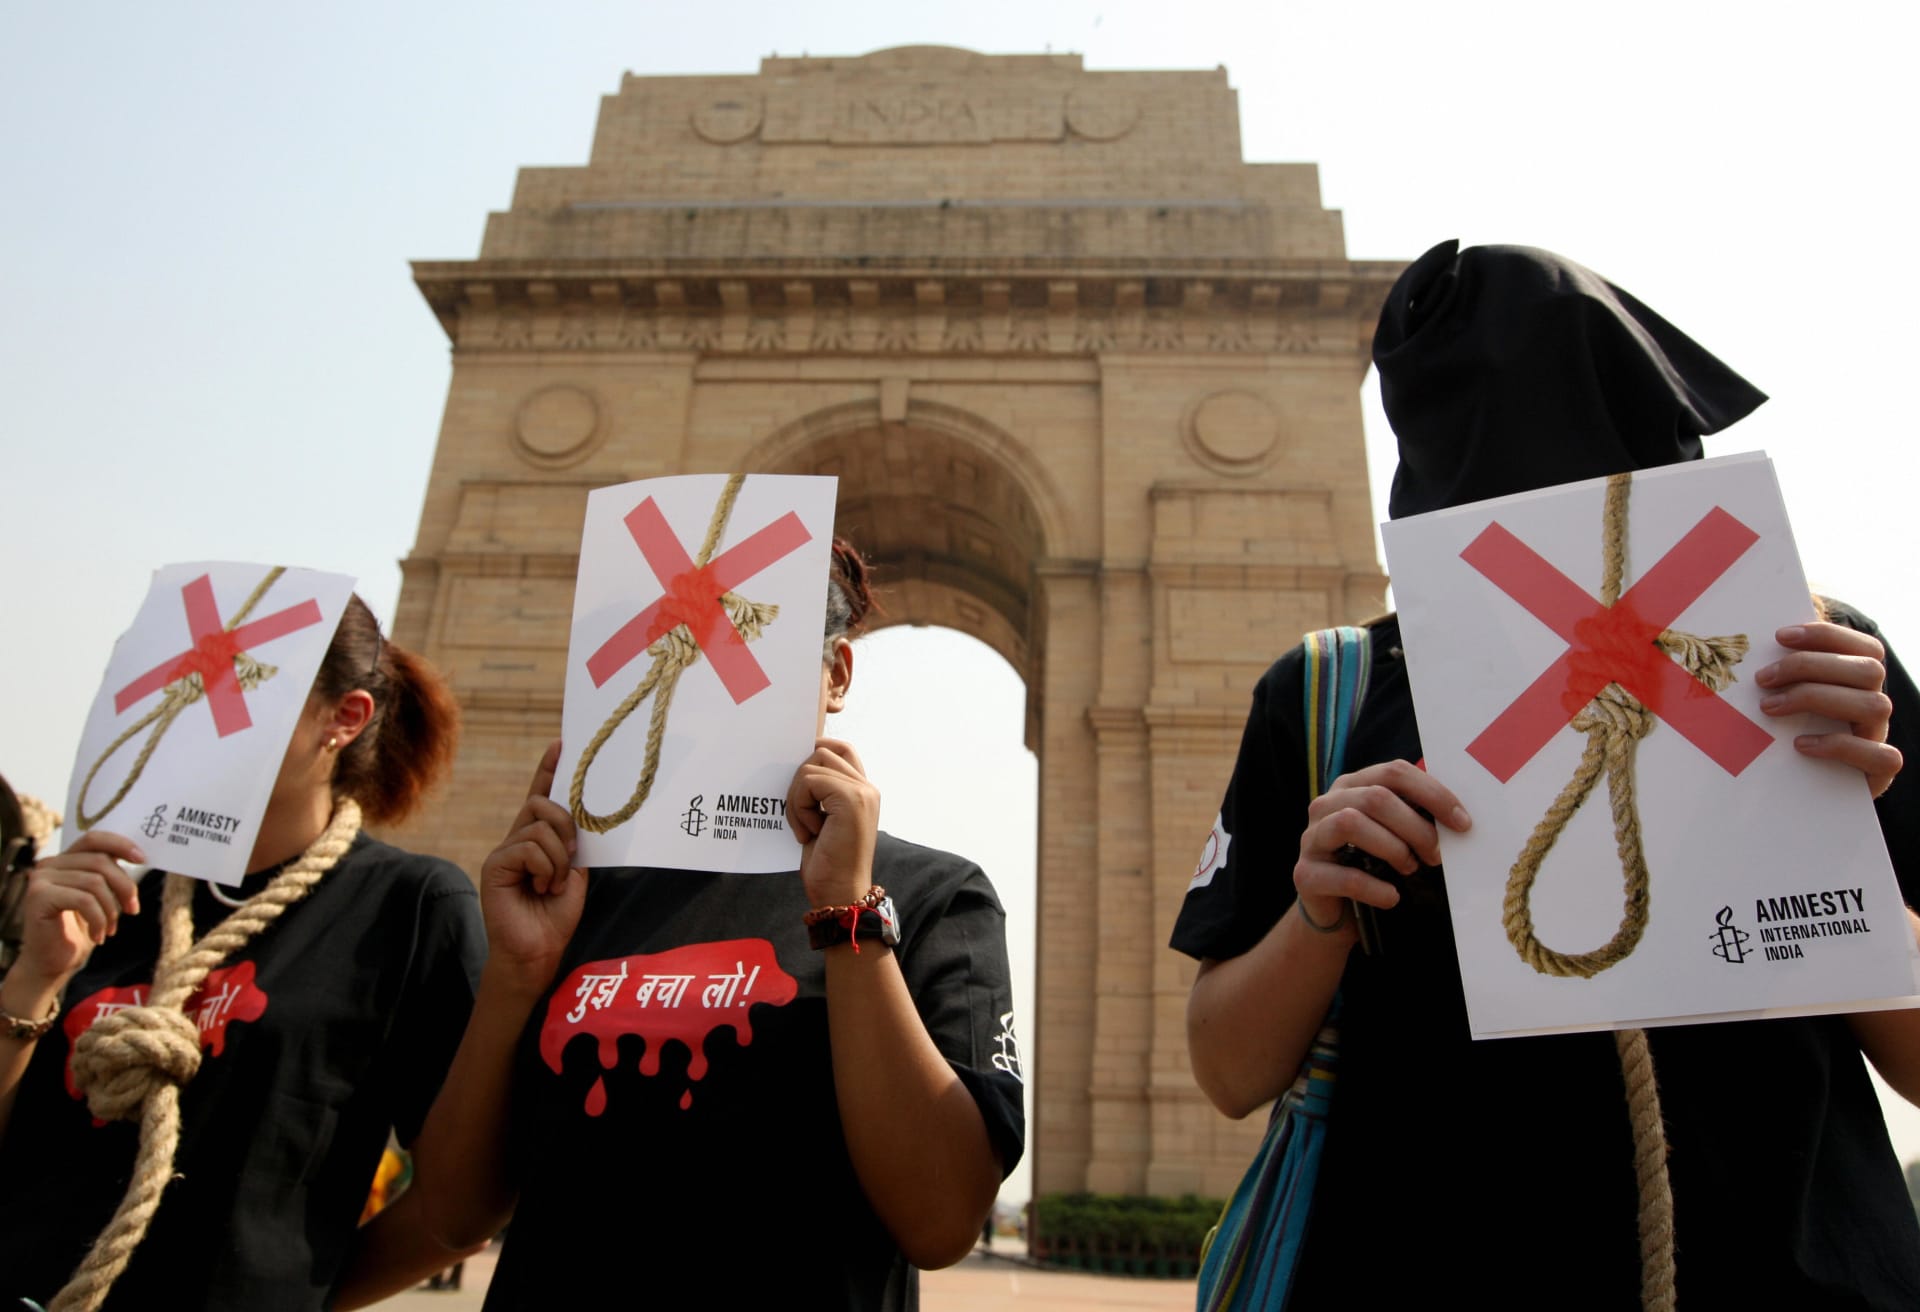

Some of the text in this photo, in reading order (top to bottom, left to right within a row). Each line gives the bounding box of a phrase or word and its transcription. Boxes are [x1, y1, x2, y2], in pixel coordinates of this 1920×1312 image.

[716, 794, 787, 816] AMNESTY
[176, 806, 241, 833] AMNESTY
[714, 815, 783, 831] INTERNATIONAL
[167, 834, 189, 846] INDIA
[171, 823, 232, 845] INTERNATIONAL
[713, 828, 738, 841] INDIA
[1756, 888, 1865, 923] AMNESTY
[1760, 918, 1871, 943] INTERNATIONAL
[1764, 944, 1804, 961] INDIA
[566, 961, 761, 1024] मुझे बचा लो!
